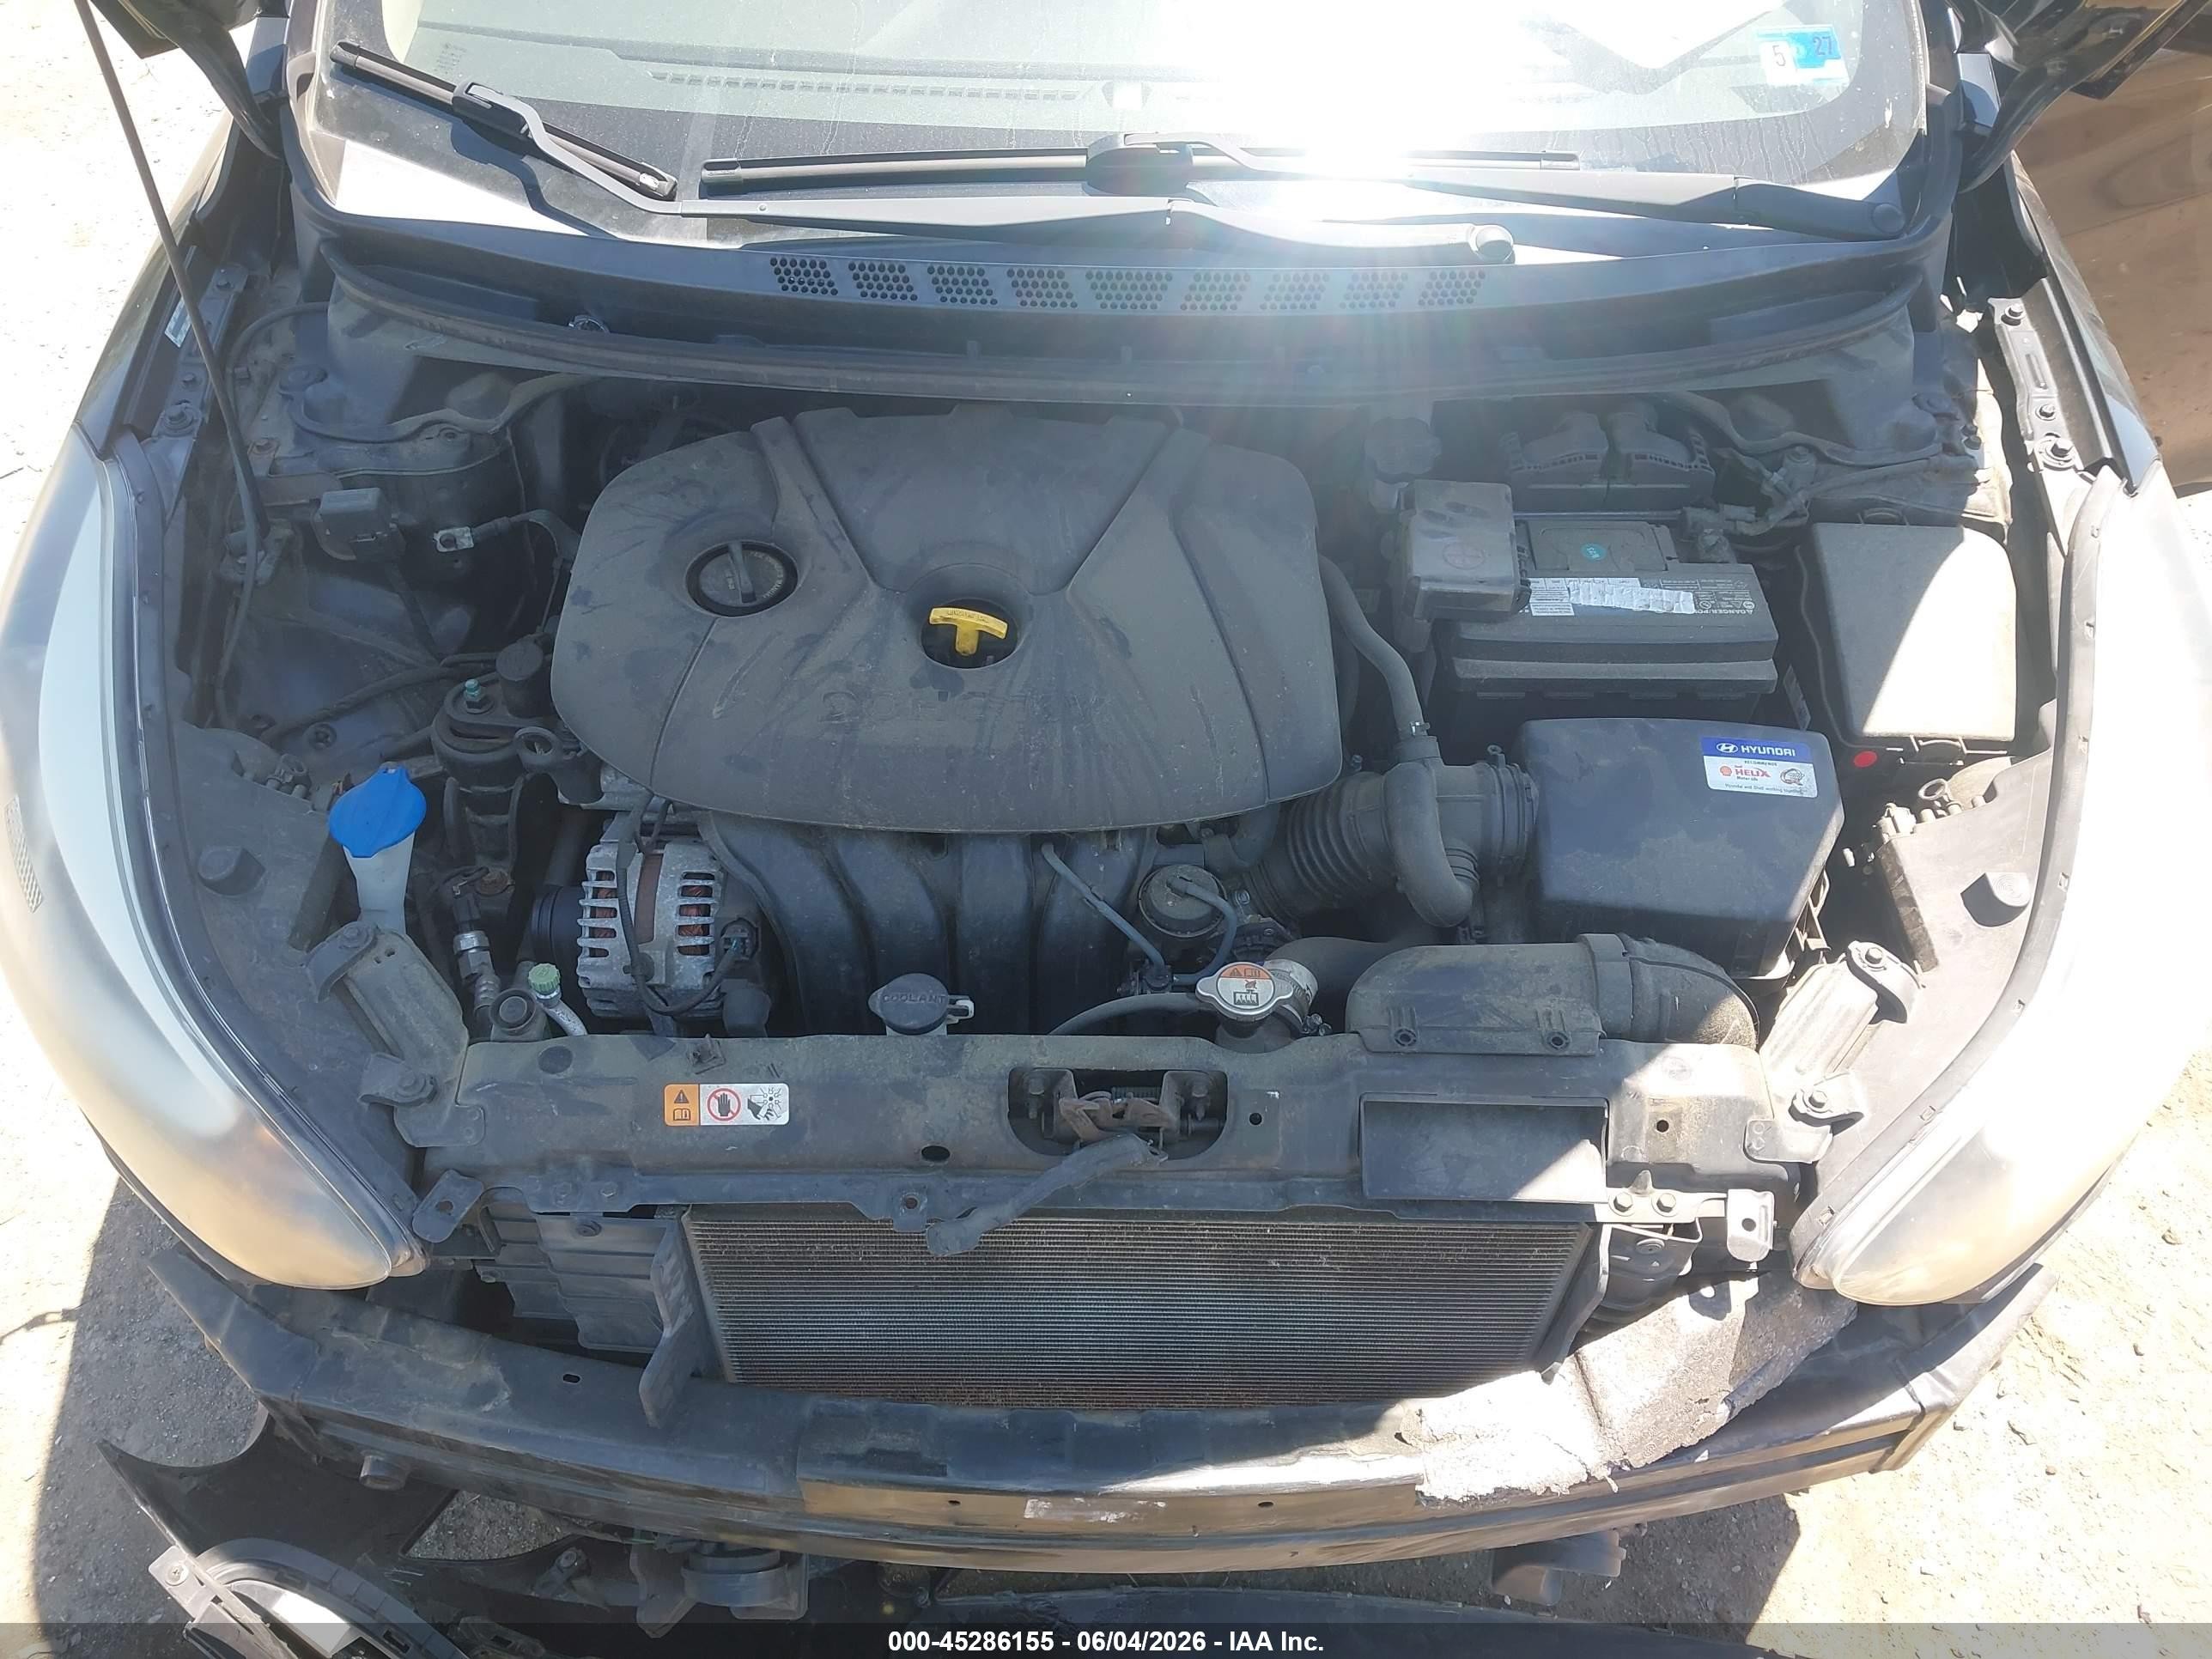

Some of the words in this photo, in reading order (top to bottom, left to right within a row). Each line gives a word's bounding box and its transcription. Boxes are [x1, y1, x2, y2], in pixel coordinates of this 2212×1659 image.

[1772, 45, 1786, 67] 5
[1813, 36, 1832, 56] 27
[1741, 745, 1796, 757] HYUNDAI
[1735, 768, 1771, 778] HELIX
[882, 994, 946, 1004] COOLANT
